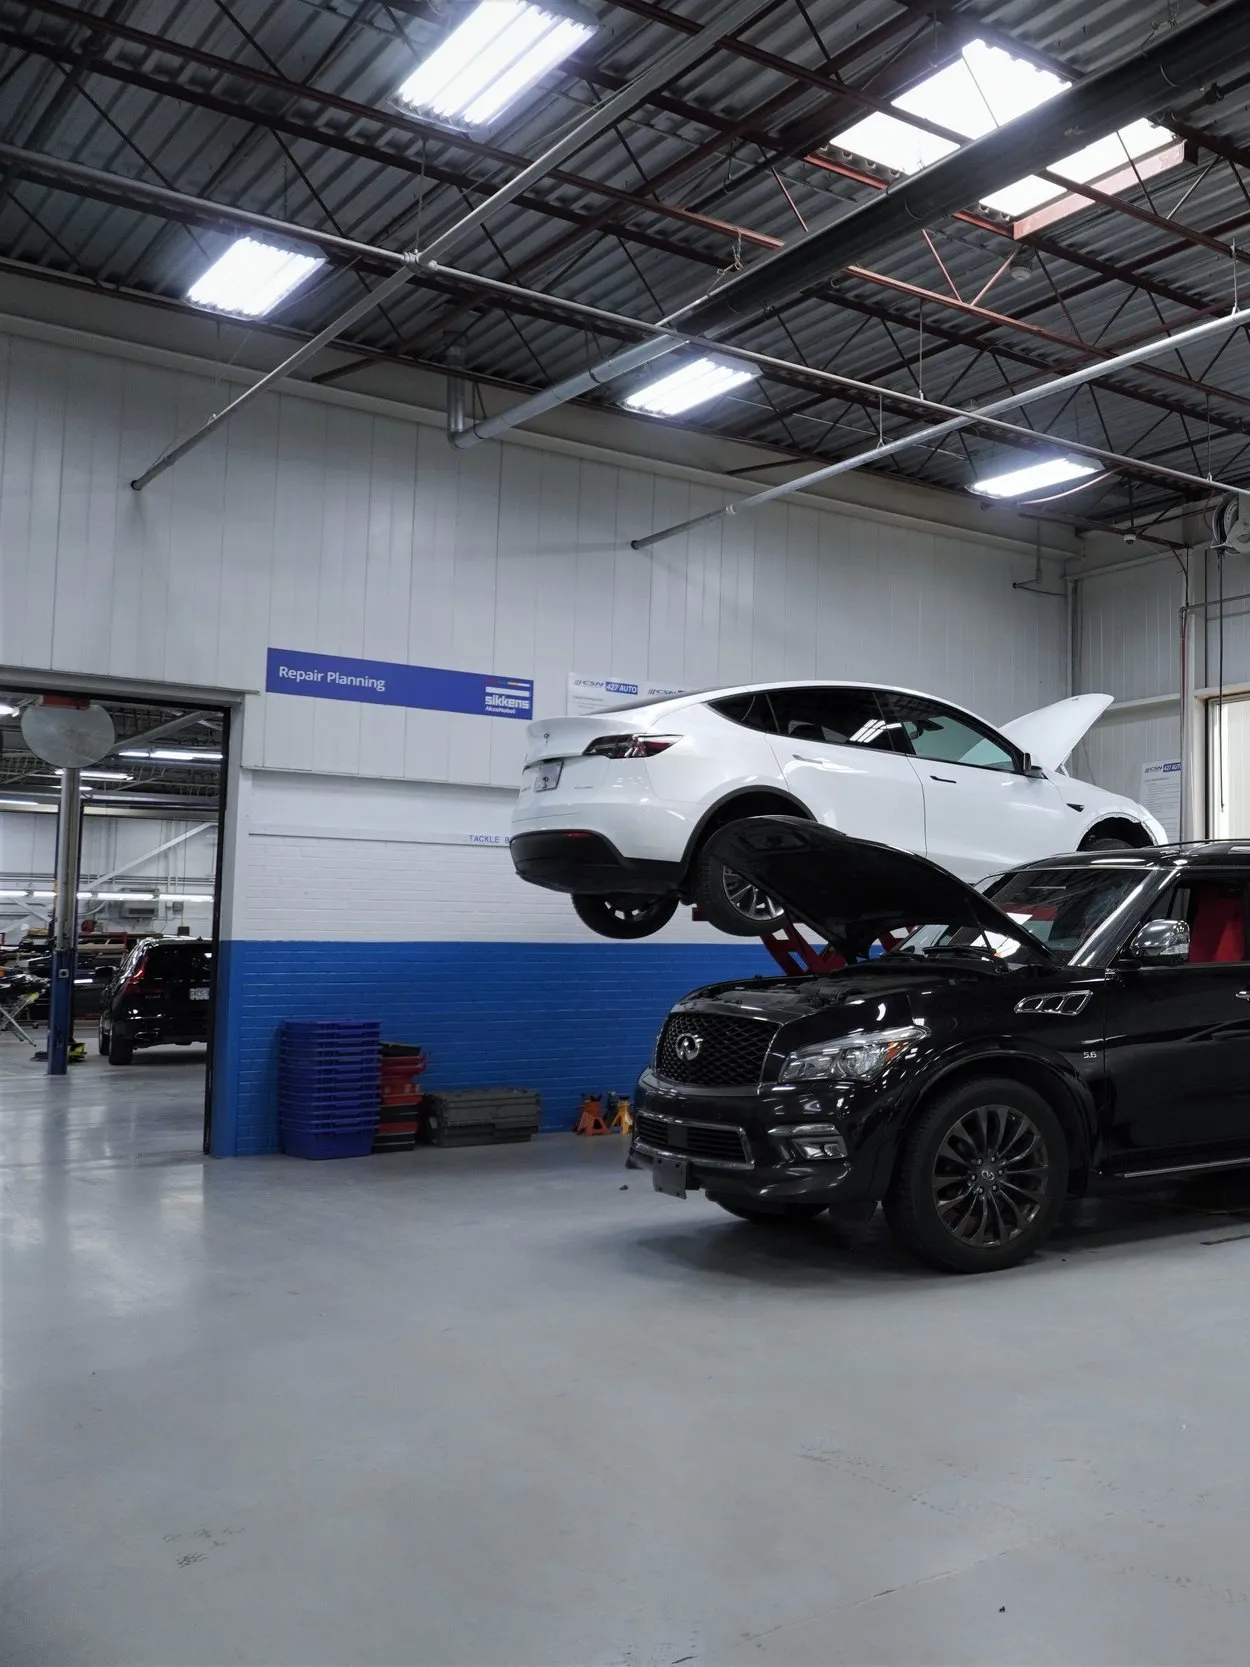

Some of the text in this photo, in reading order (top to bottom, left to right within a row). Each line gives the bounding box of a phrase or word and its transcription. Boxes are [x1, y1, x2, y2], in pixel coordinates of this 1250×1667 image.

[279, 666, 386, 692] Repair Planning
[606, 683, 619, 691] 427
[619, 685, 638, 694] AUTO
[485, 694, 530, 710] sikkens
[469, 835, 501, 843] TACKLE
[1083, 1051, 1097, 1059] 5.6
